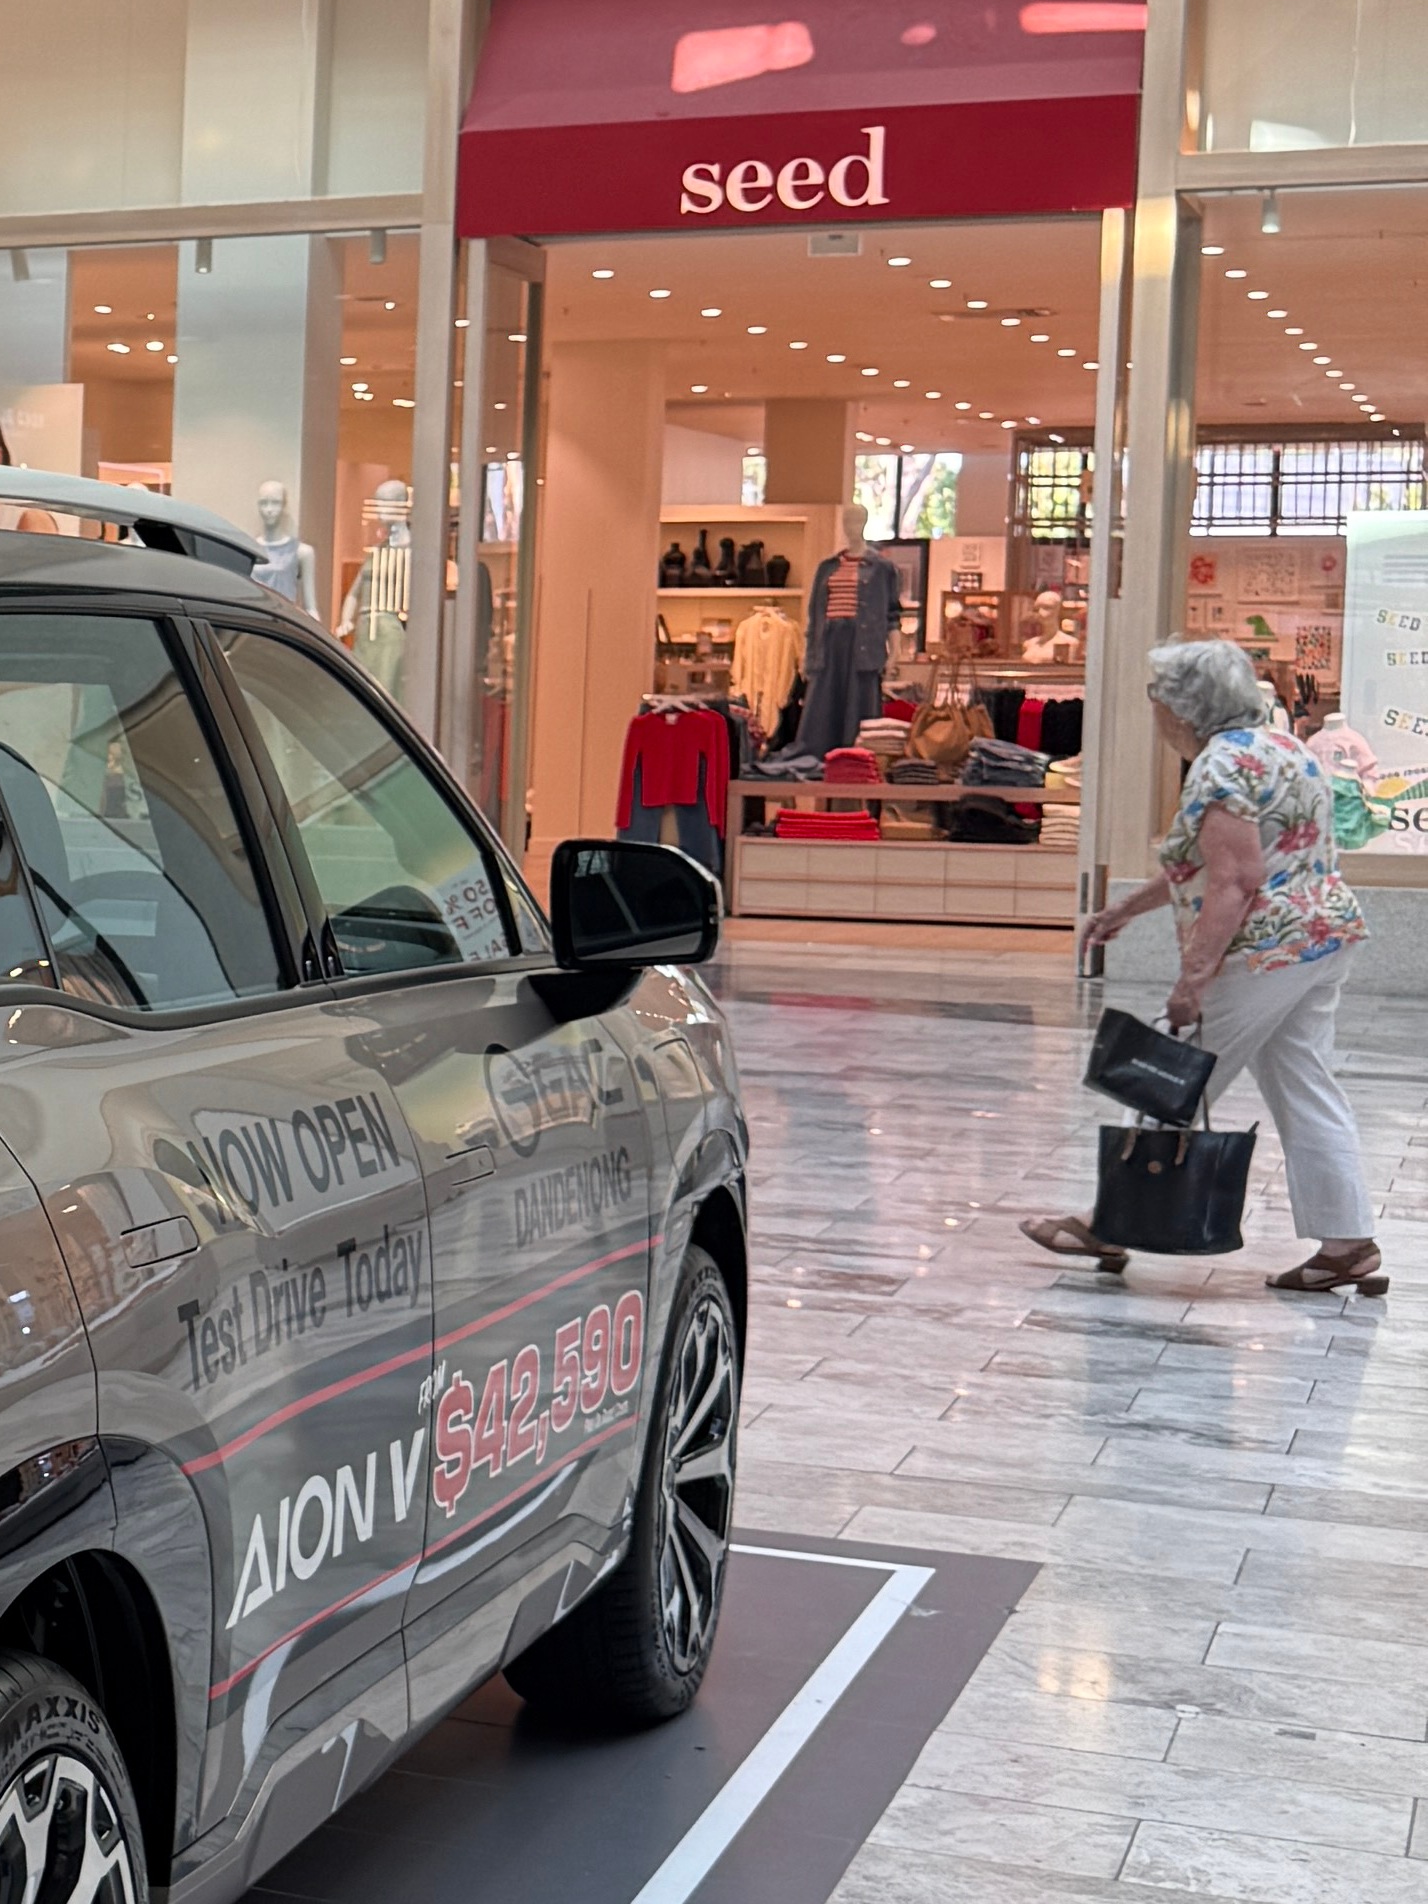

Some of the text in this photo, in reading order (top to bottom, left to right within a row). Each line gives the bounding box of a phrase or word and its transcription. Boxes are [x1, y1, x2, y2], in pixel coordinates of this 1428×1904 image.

[680, 126, 890, 214] seed
[1377, 608, 1422, 632] SEED
[186, 1091, 400, 1225] NOW OPEN
[514, 1146, 632, 1249] DANDENONG
[177, 1224, 423, 1391] Test Drive Today
[225, 1289, 644, 1630] AION V $42,590
